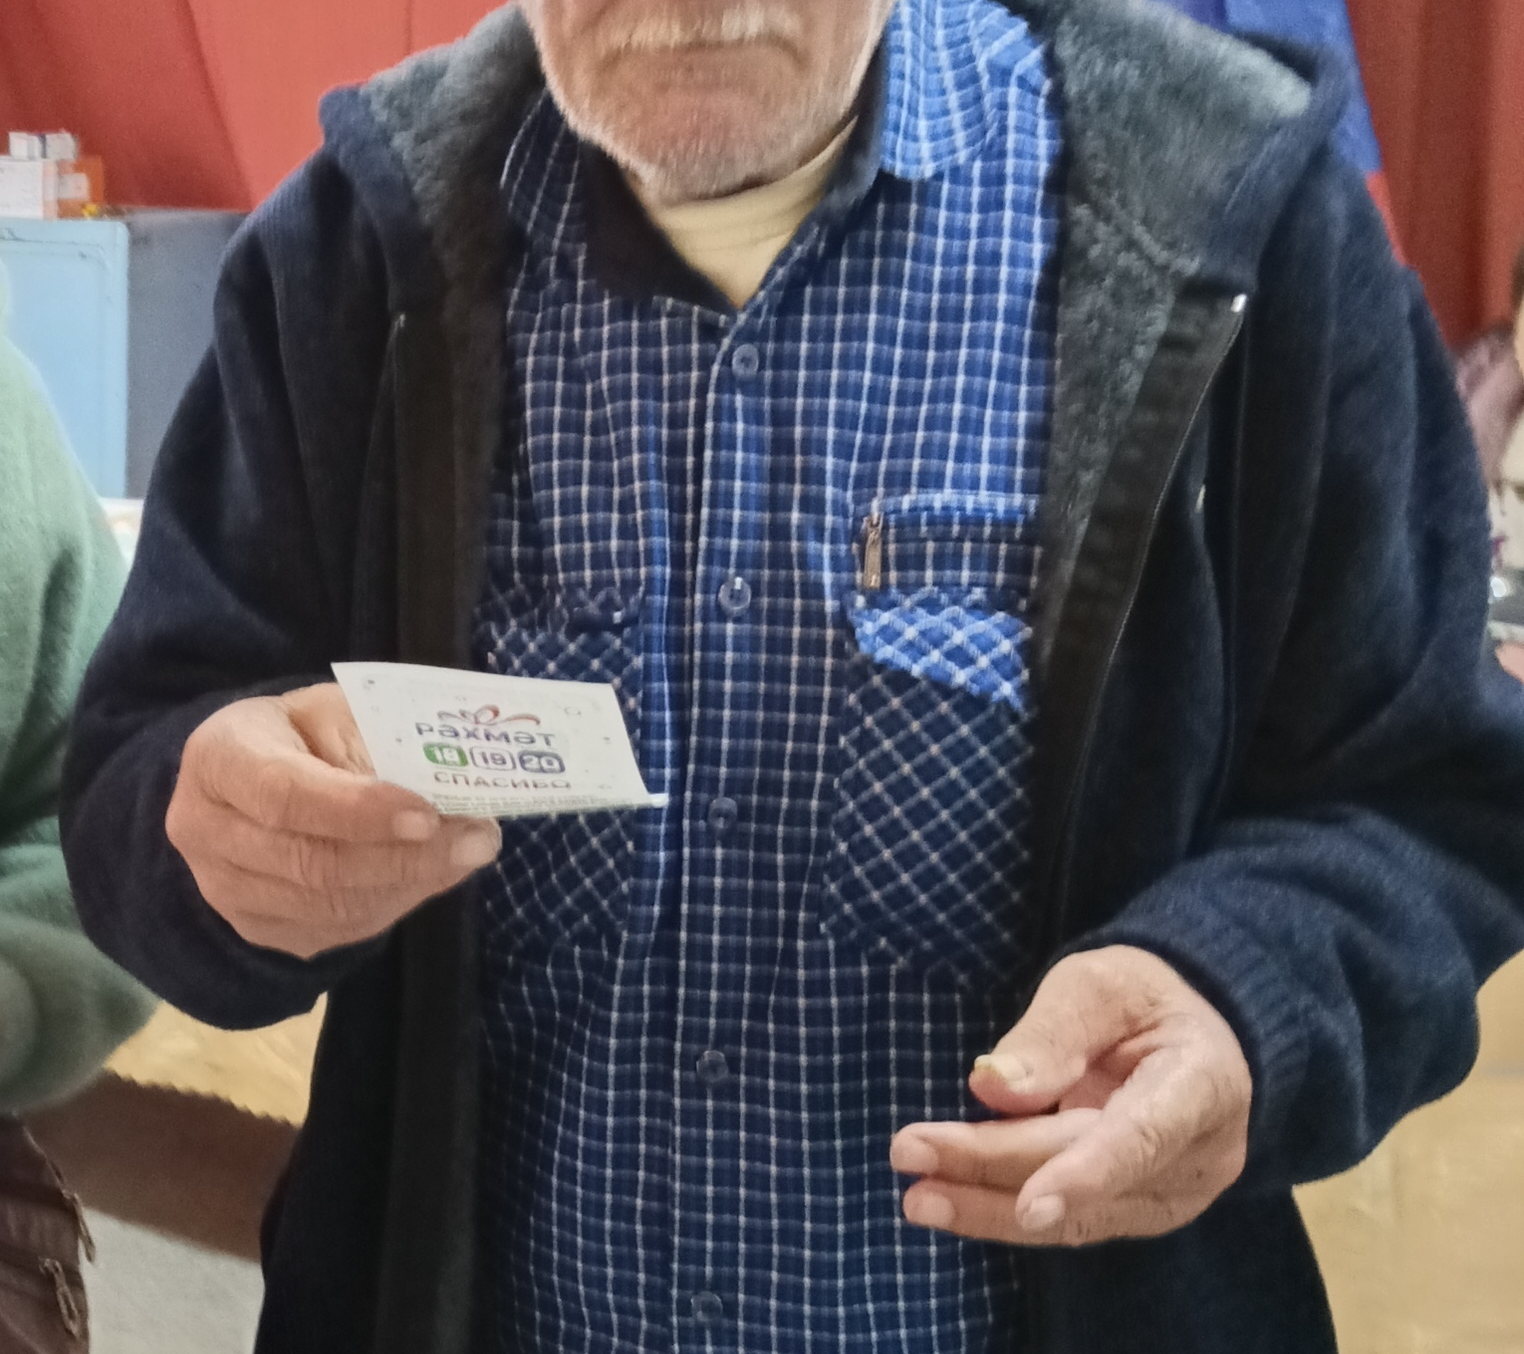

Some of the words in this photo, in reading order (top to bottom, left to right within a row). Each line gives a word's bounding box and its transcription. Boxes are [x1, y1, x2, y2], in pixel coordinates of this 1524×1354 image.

[477, 751, 508, 767] 19
[523, 755, 560, 771] 20
[433, 771, 572, 790] СПАСИБО
